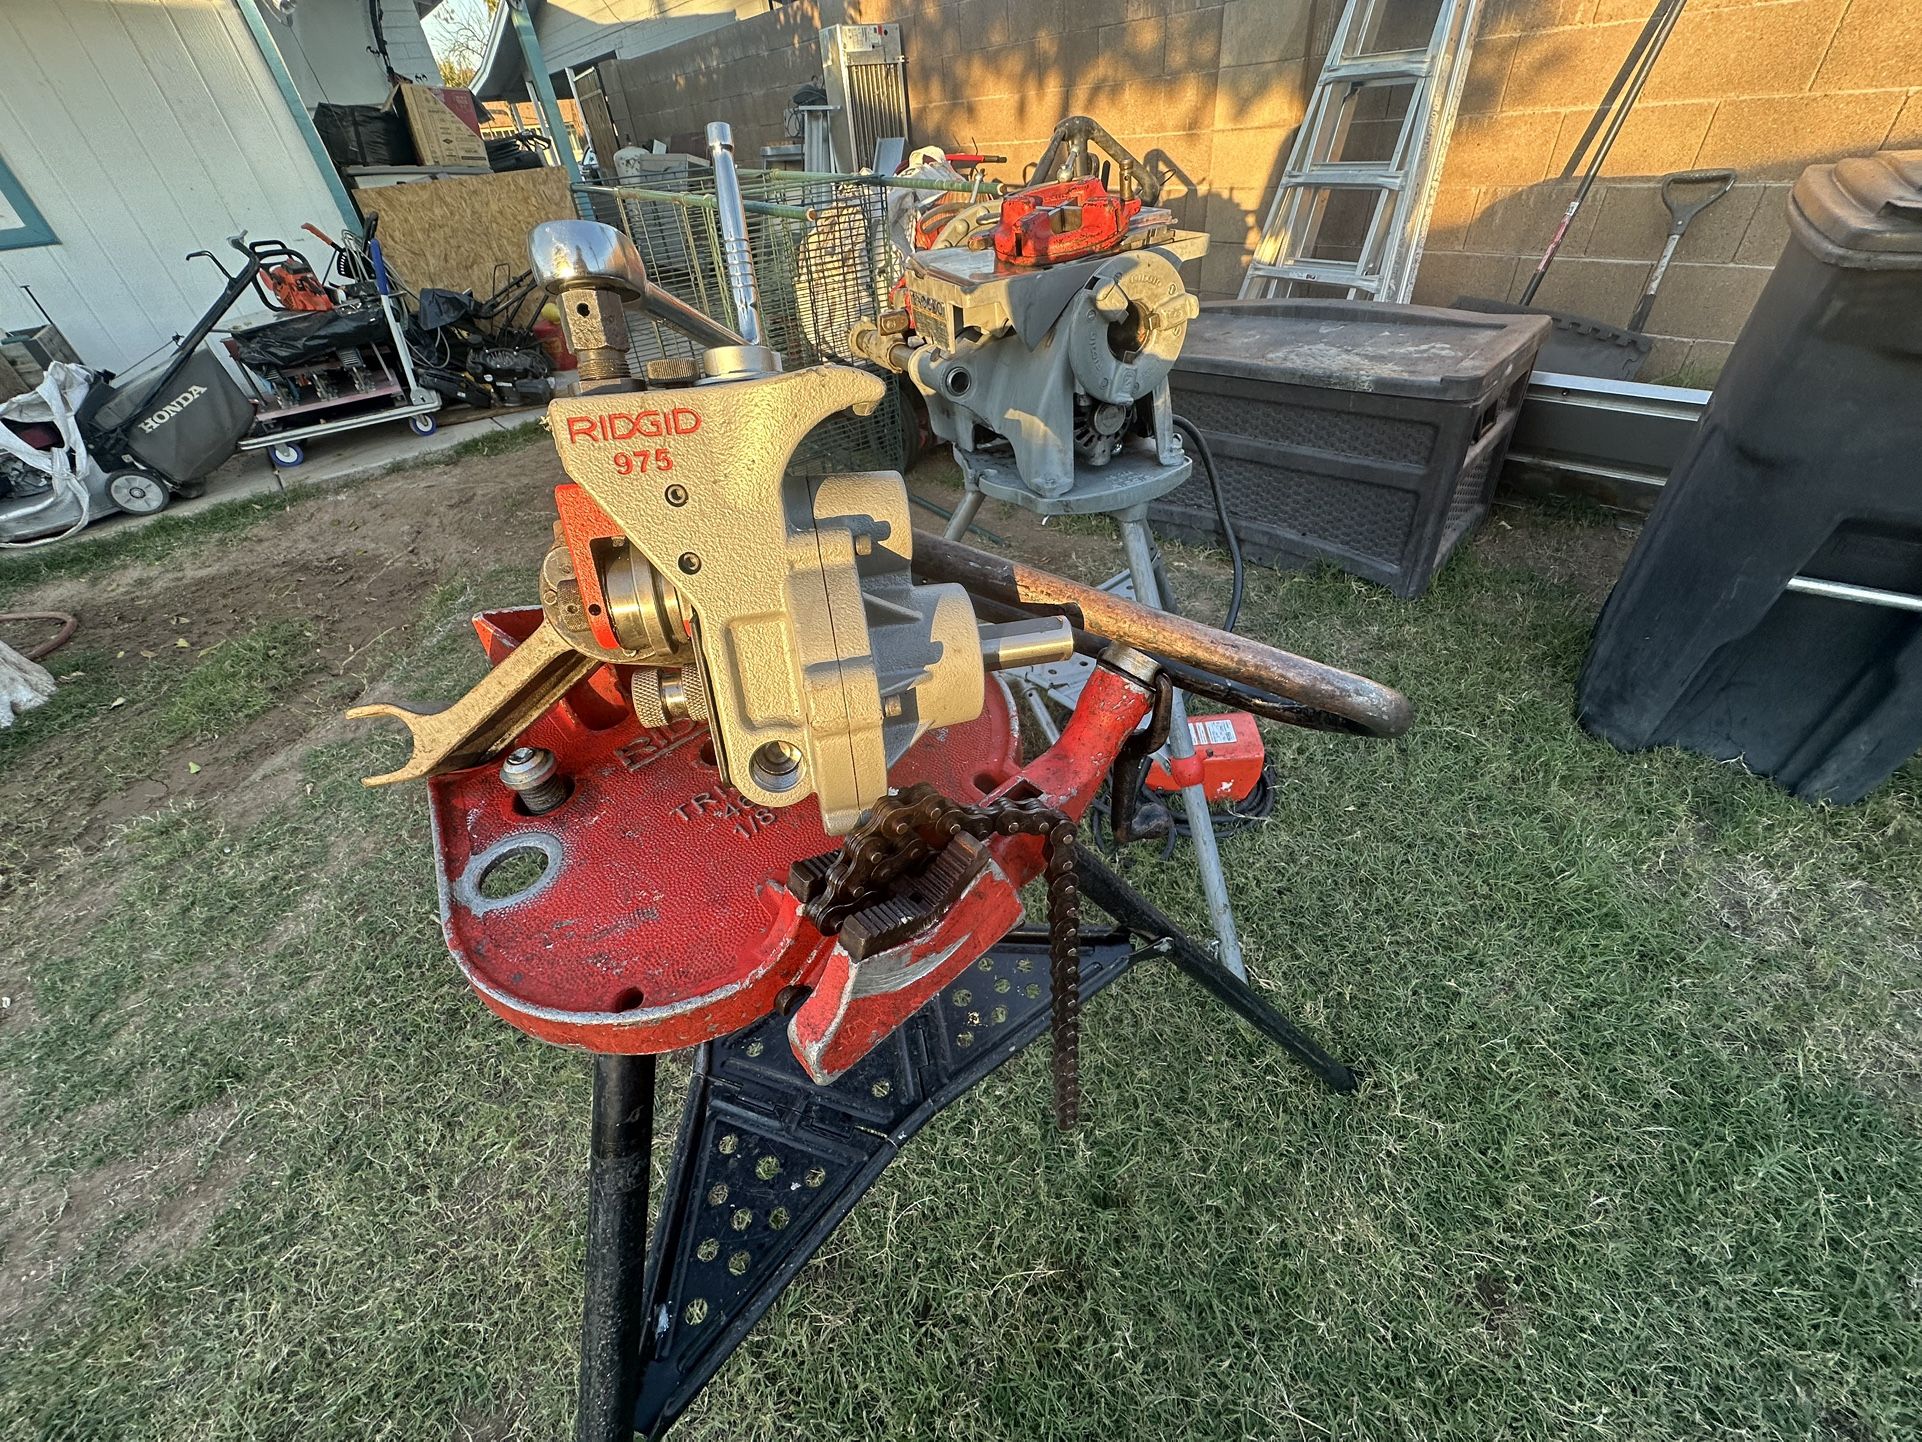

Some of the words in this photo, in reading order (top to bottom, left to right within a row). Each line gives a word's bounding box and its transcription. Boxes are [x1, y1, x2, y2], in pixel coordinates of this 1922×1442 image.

[138, 385, 207, 434] HONDA
[567, 407, 702, 444] RIDGID
[613, 448, 673, 475] 975
[615, 717, 697, 767] RID
[669, 785, 728, 821] TRI
[724, 794, 756, 819] 46
[733, 808, 777, 839] 1/8
